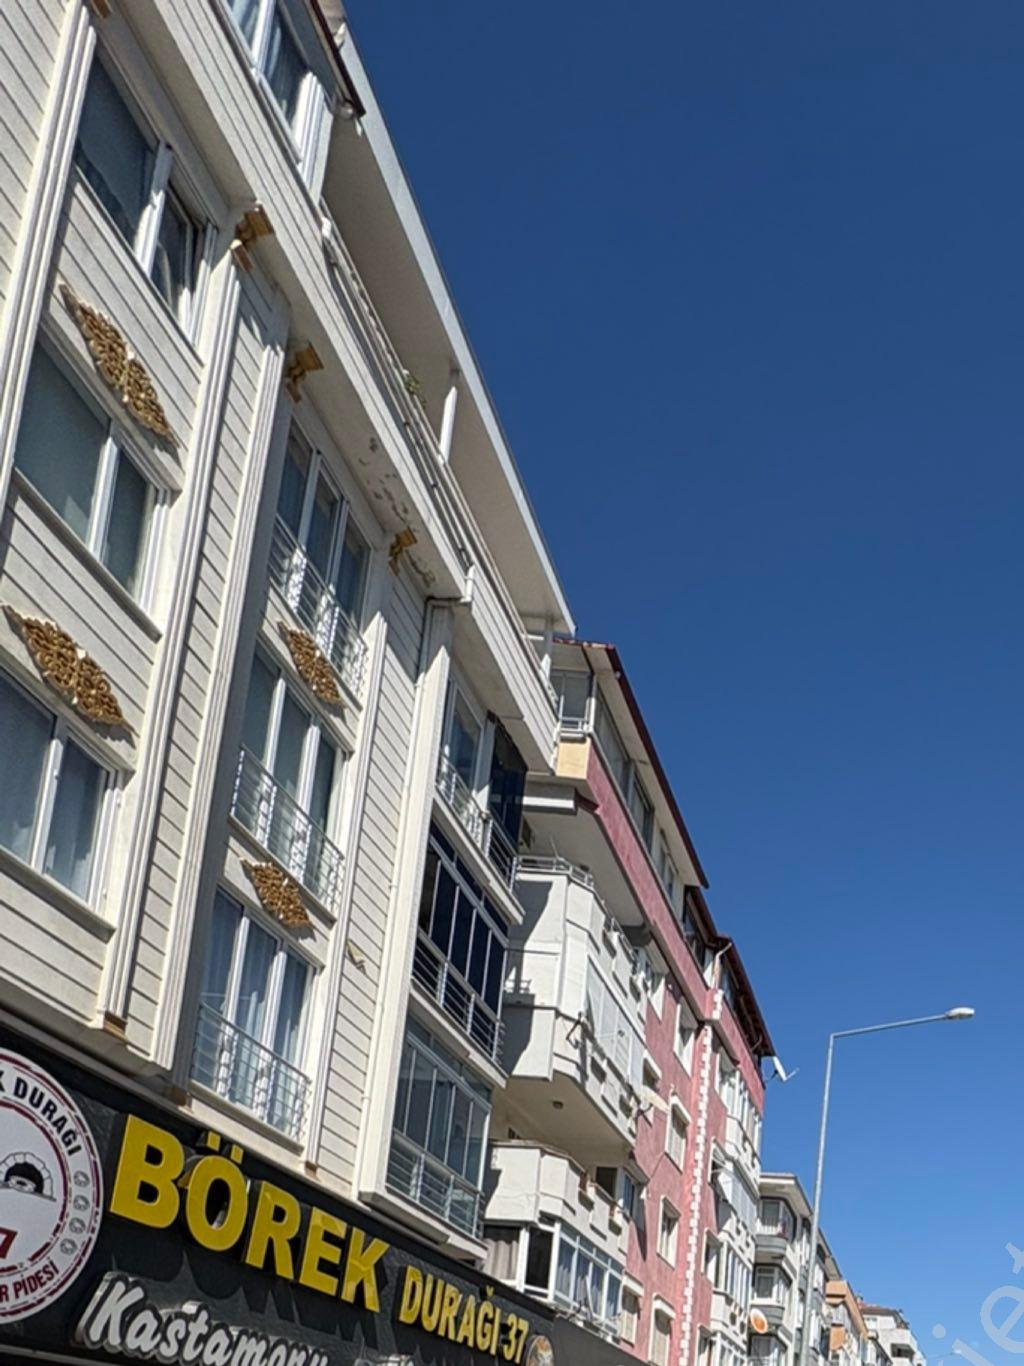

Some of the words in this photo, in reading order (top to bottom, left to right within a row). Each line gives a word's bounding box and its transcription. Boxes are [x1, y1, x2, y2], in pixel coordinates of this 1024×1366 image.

[110, 1114, 390, 1313] BÖREK
[399, 1265, 501, 1356] DURAĞI
[502, 1314, 529, 1364] 37
